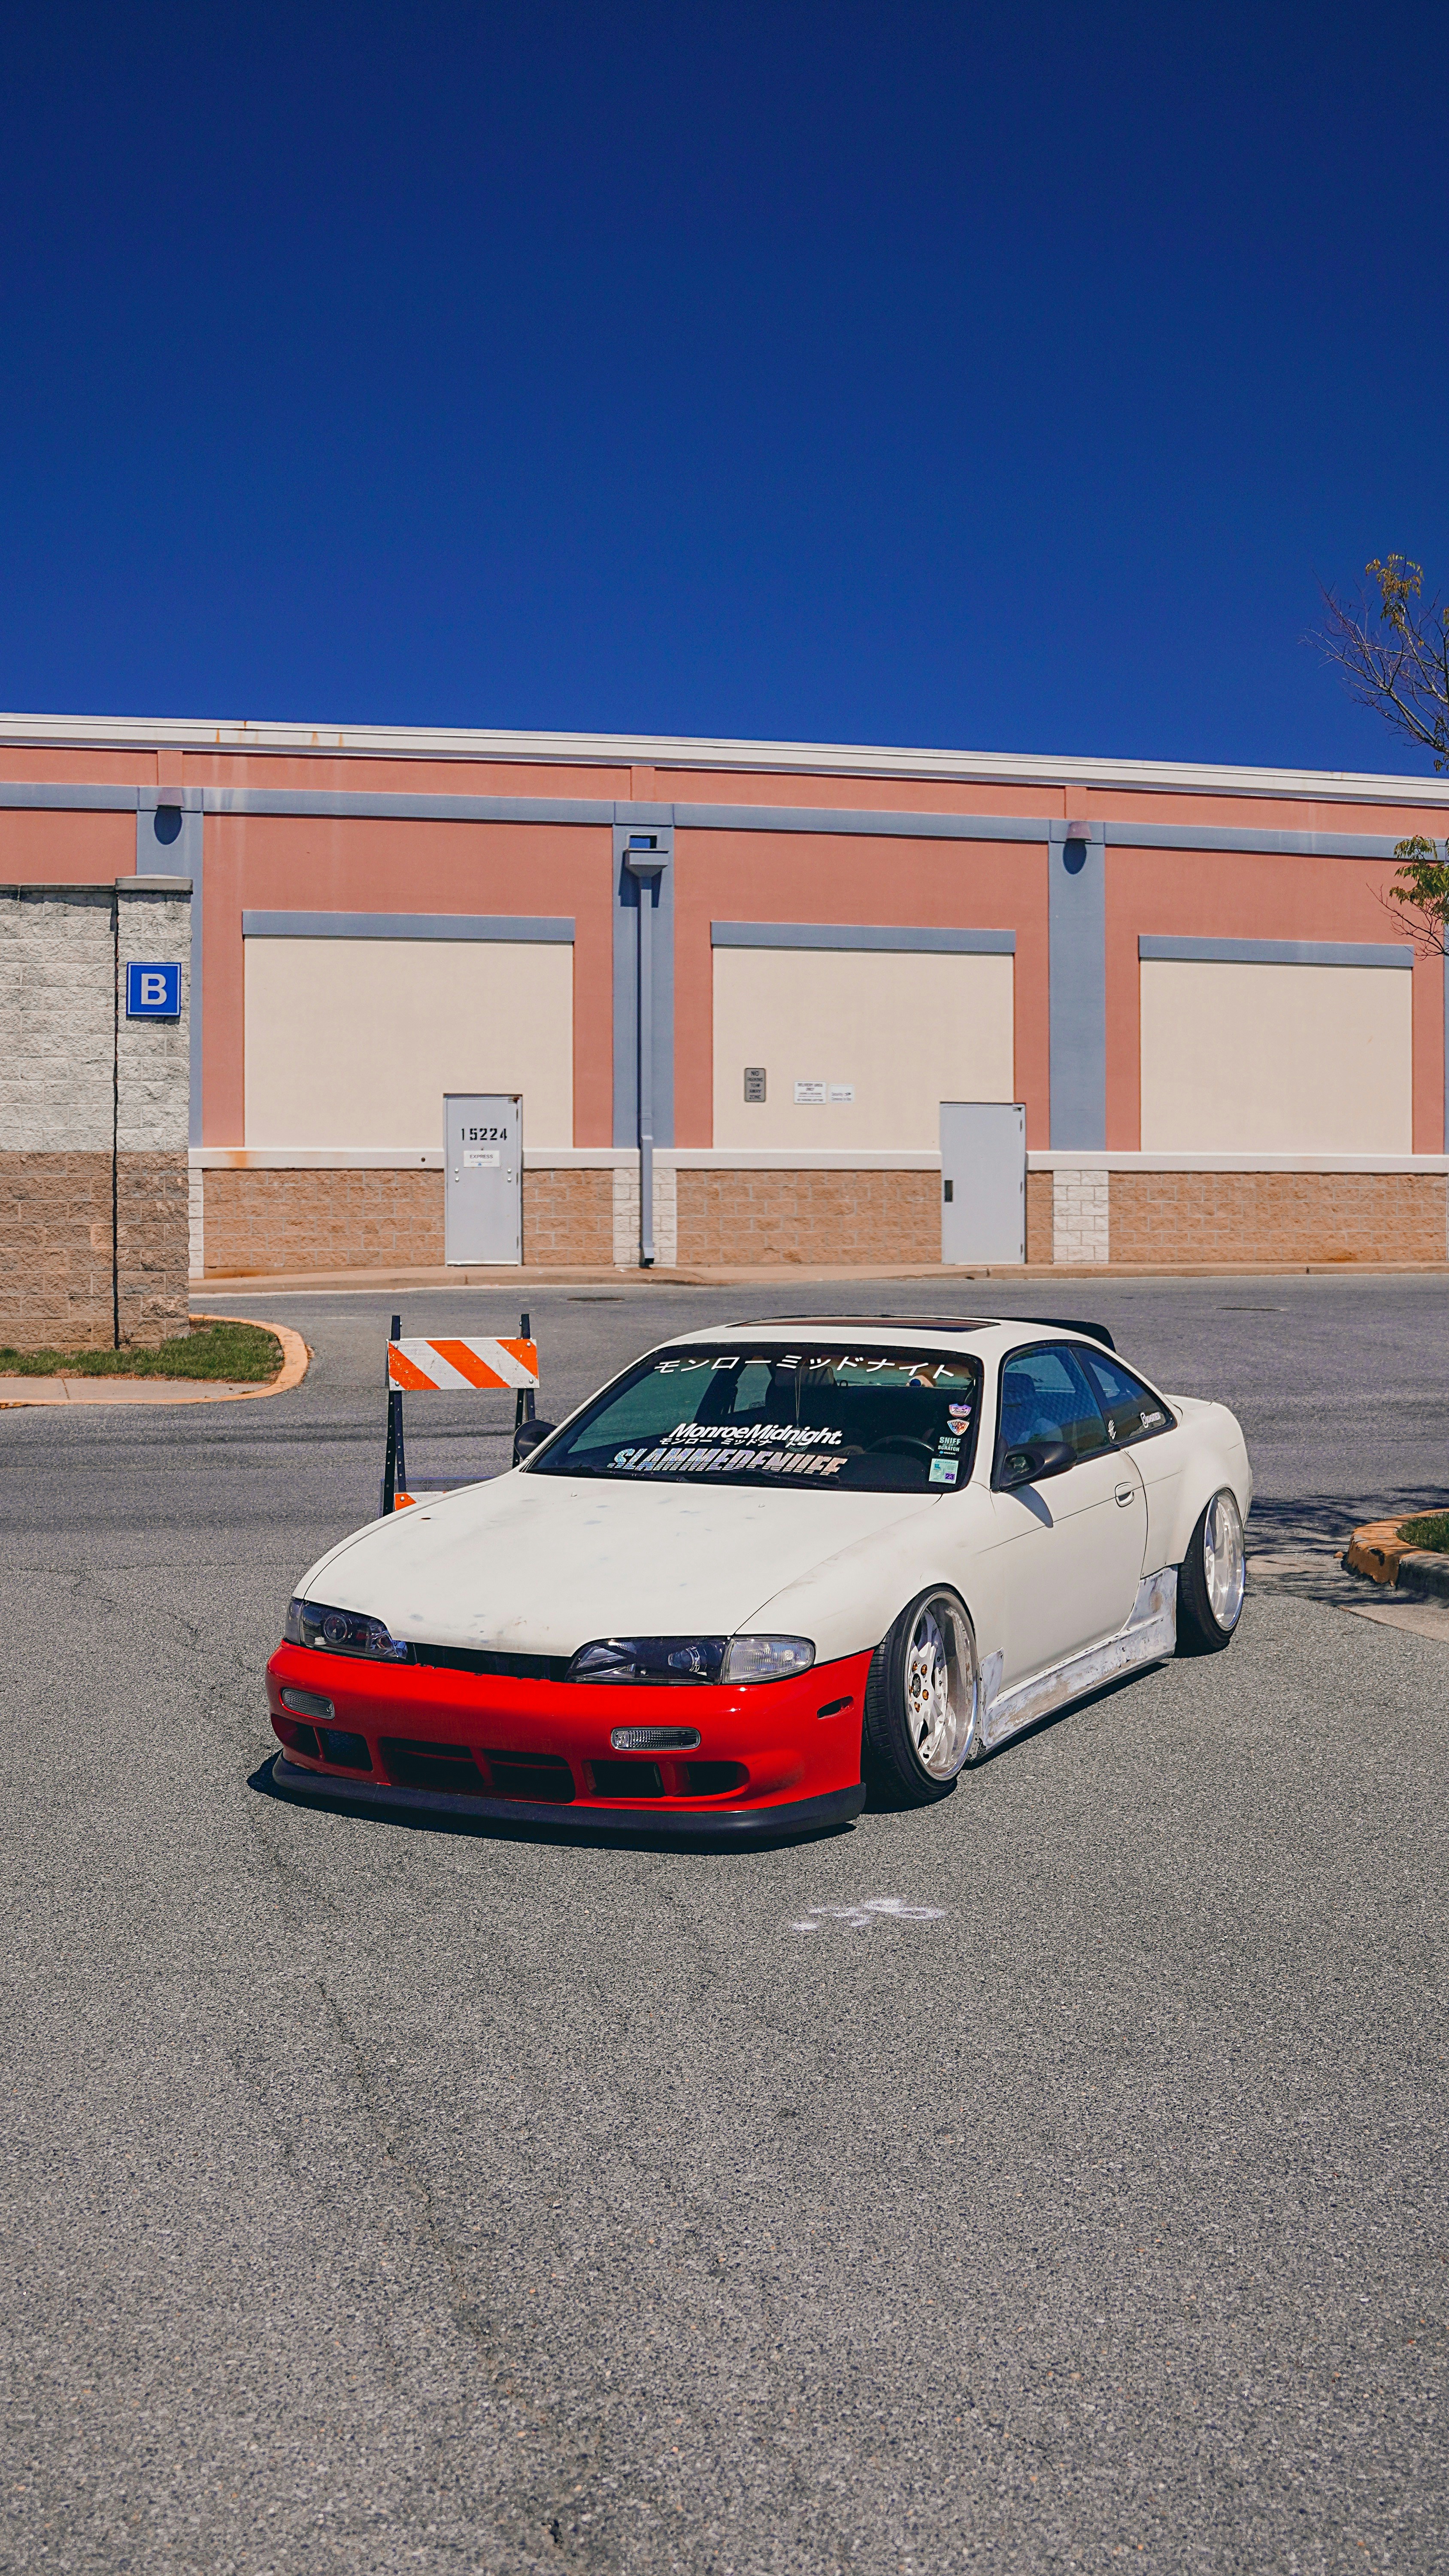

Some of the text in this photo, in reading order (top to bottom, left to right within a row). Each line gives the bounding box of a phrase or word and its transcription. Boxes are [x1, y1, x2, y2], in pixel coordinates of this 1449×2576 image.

[141, 973, 167, 1005] B
[461, 1128, 507, 1140] 15224
[669, 1423, 842, 1446] MonroeMidnight.
[939, 1437, 961, 1445] SNIFF
